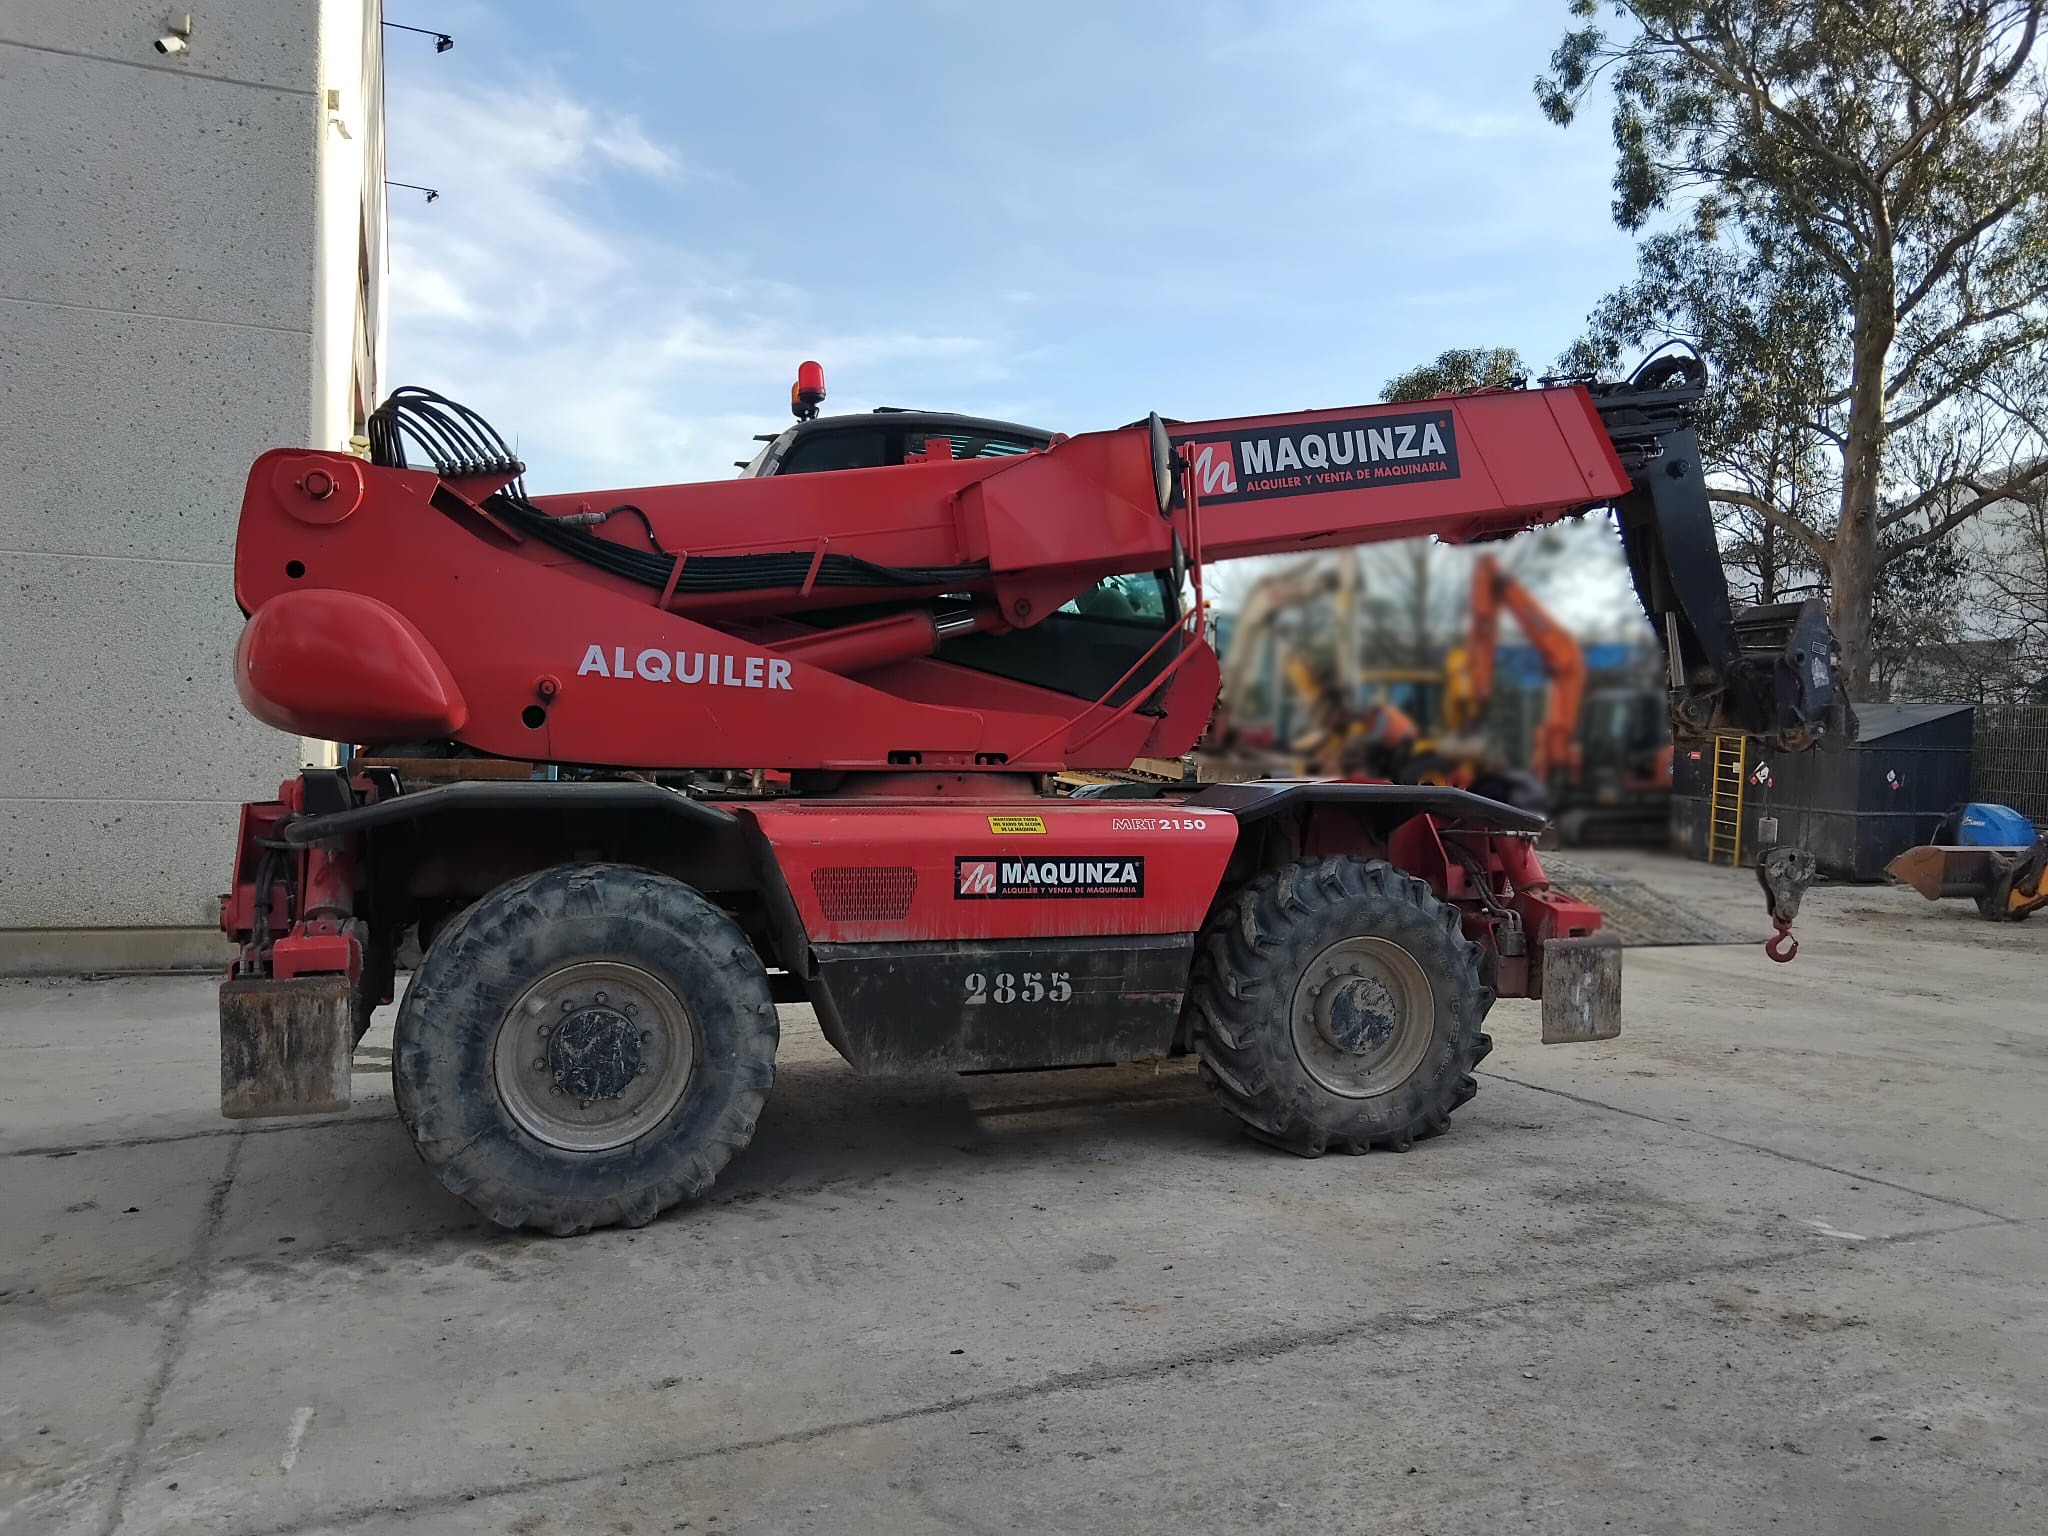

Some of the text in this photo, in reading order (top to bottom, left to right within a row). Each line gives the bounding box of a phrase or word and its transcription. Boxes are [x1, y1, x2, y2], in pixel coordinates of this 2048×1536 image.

[1240, 422, 1447, 475] MAQUINZA
[1246, 461, 1447, 492] ALQUILER Y VENTA DE MAQUINARIA
[577, 644, 793, 690] ALQUILER
[1112, 818, 1207, 831] MRT 2150
[1001, 862, 1138, 886] MAQUINZA
[1001, 886, 1038, 894] ALQUILER
[1048, 886, 1073, 894] VENTA
[1075, 886, 1084, 894] DE
[1086, 886, 1137, 894] MAQUINARIA
[964, 972, 1073, 1005] 2855
